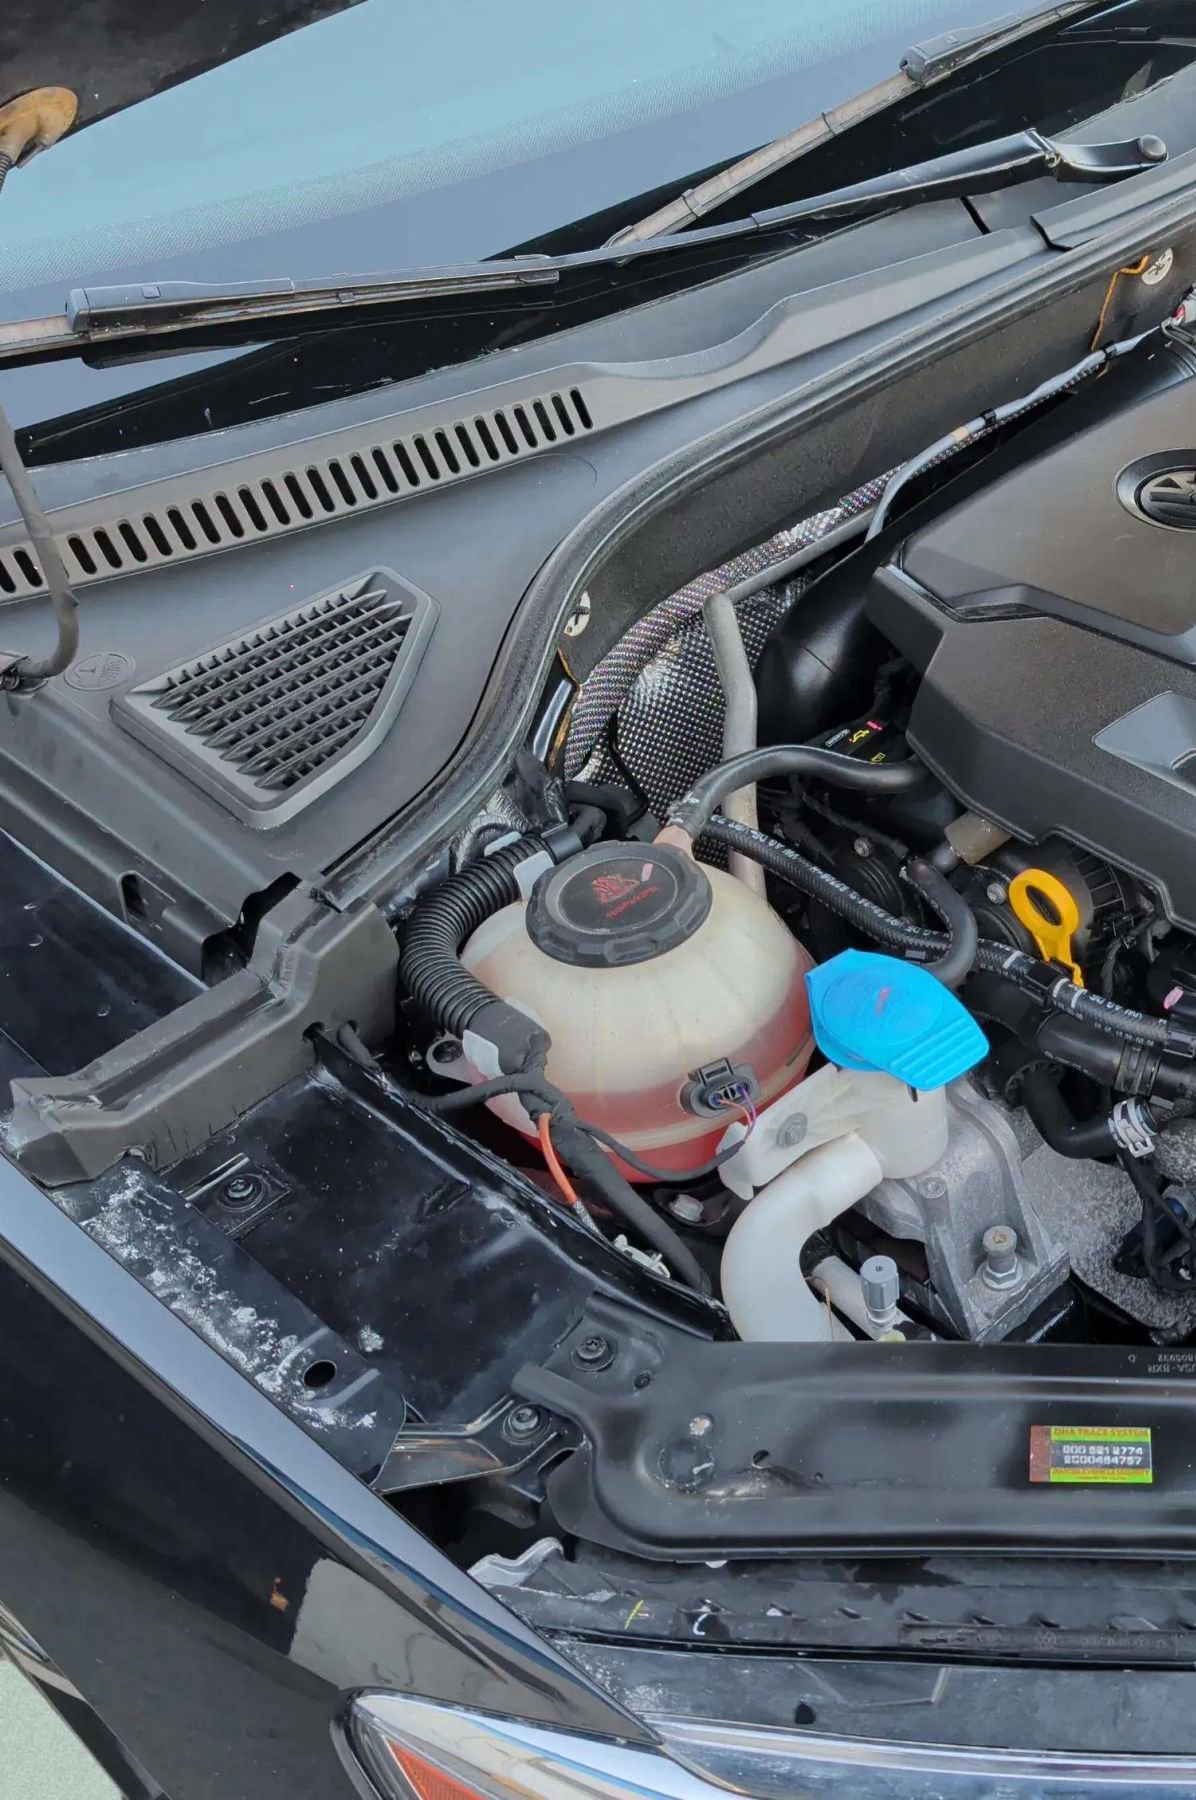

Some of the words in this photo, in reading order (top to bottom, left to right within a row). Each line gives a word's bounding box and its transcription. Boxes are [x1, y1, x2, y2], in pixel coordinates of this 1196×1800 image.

[1054, 1428, 1077, 1437] DNA
[1079, 1428, 1109, 1437] TRACE
[1112, 1428, 1149, 1437] SYSTEM
